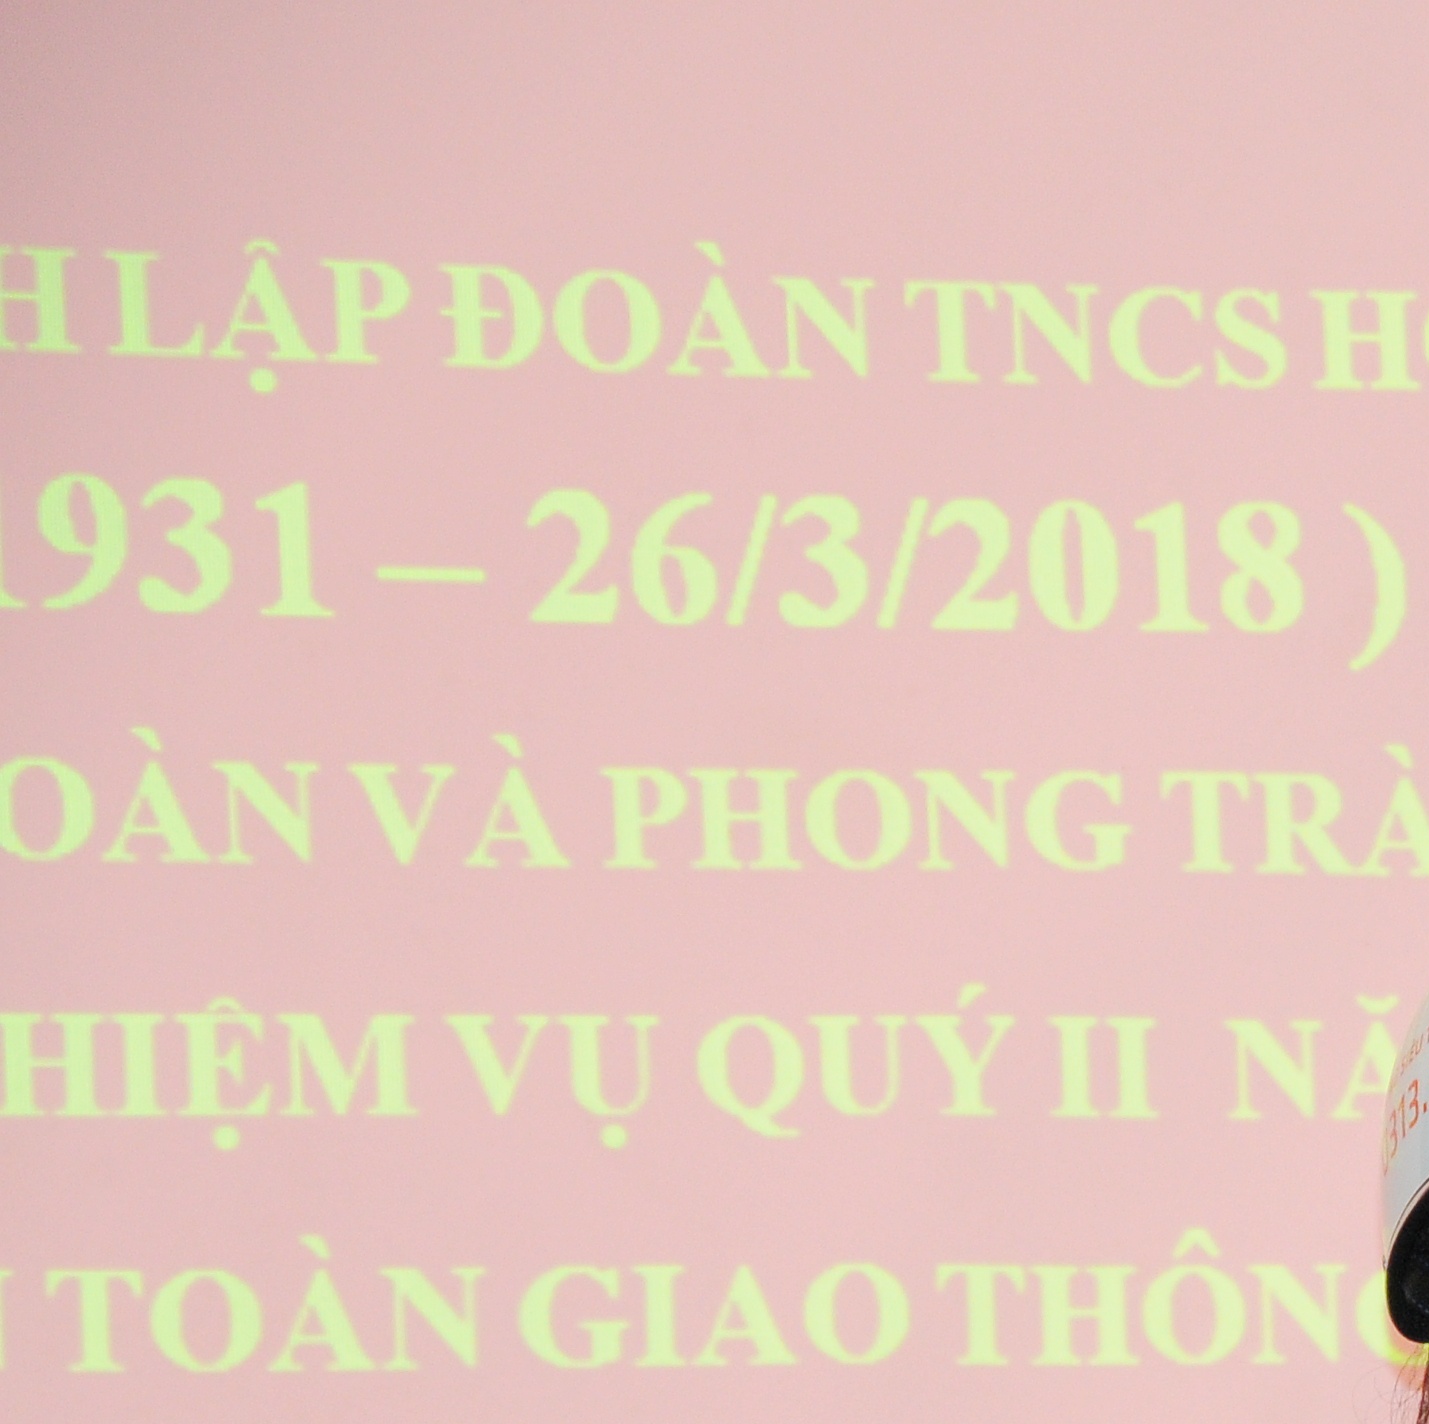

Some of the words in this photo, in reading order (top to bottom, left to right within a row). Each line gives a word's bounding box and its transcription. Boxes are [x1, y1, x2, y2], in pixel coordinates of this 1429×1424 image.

[104, 238, 412, 395] LẬP
[440, 241, 875, 378] ĐOÀN
[904, 280, 1289, 390] TNCS
[526, 487, 1305, 634] 26/3/2018
[0, 726, 320, 865] OÀN
[348, 732, 572, 869] VÀ
[600, 766, 1132, 872] PHONG
[0, 996, 418, 1152] HIỆM
[445, 1013, 660, 1150] VỤ
[696, 983, 1016, 1138] QUÝ
[1049, 1014, 1159, 1120] II
[44, 1234, 486, 1374] TOÀN
[517, 1263, 911, 1370] GIAO
